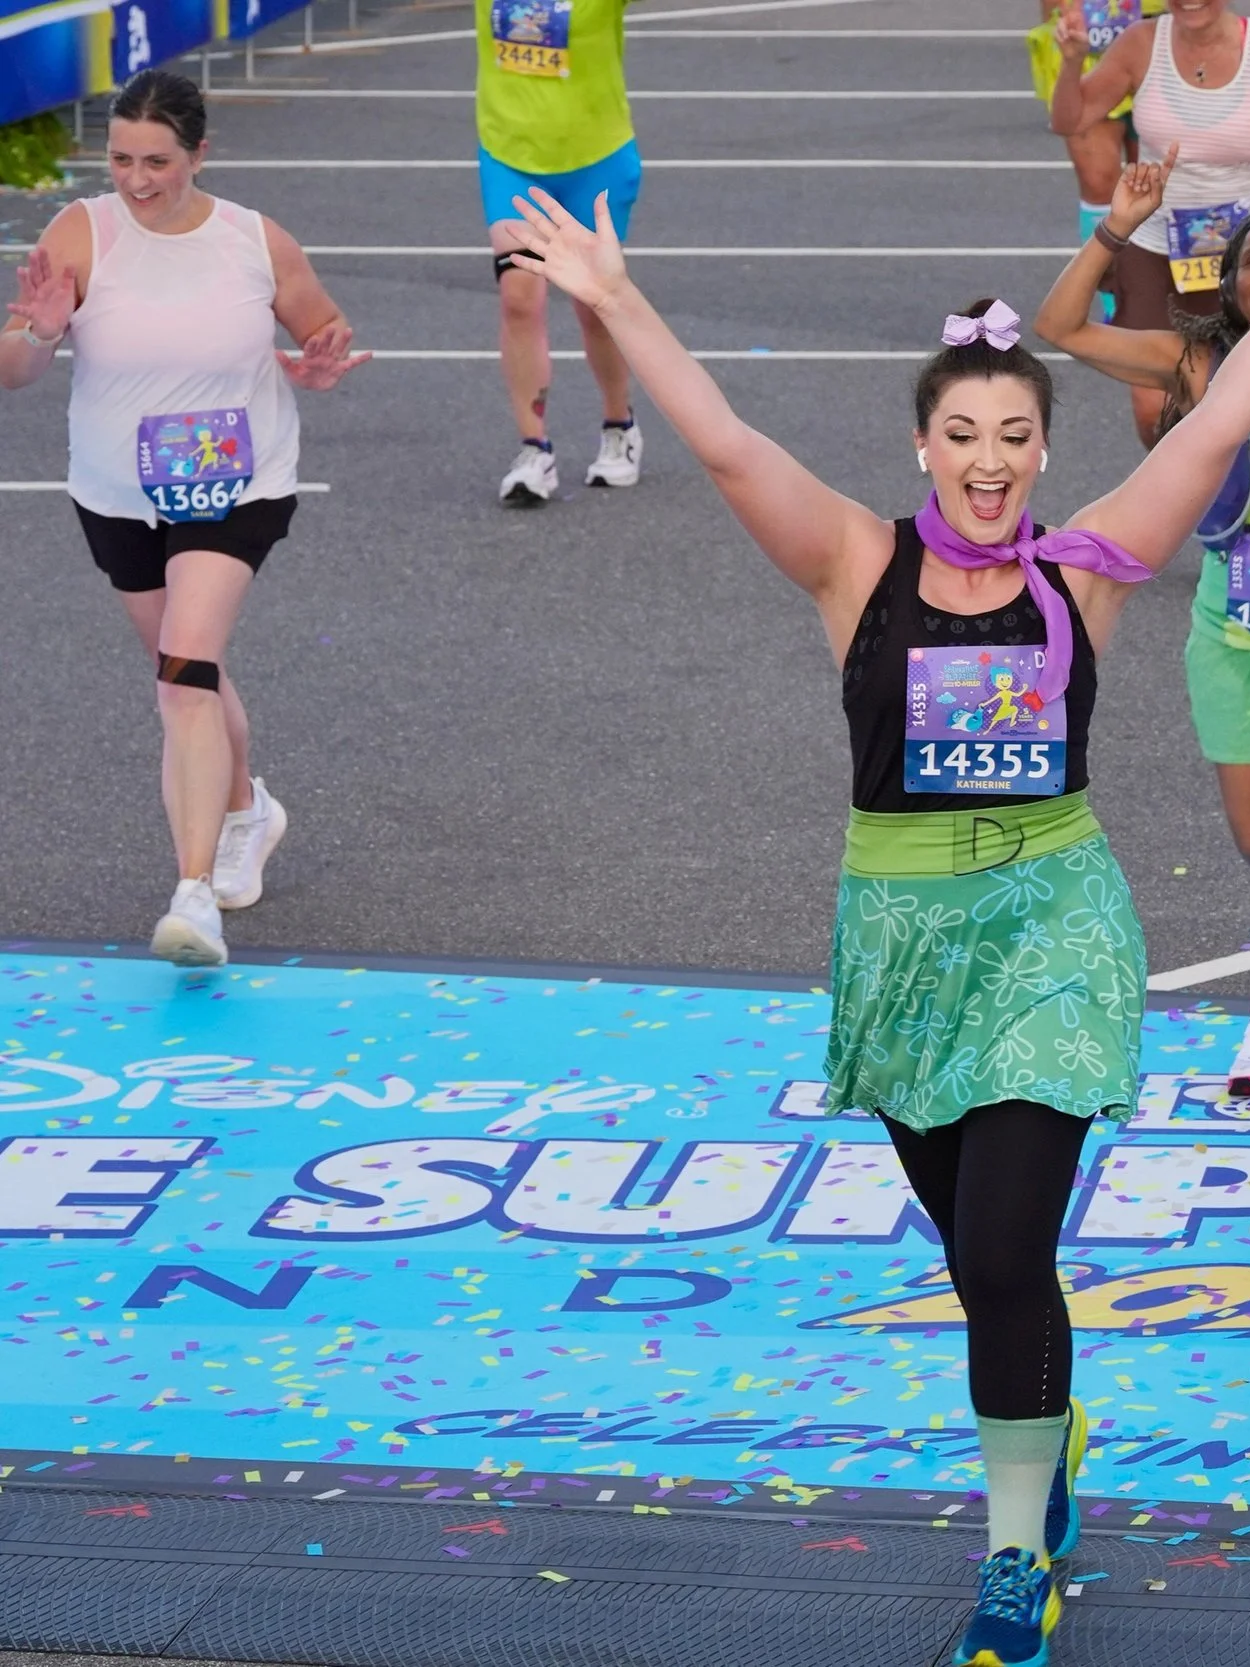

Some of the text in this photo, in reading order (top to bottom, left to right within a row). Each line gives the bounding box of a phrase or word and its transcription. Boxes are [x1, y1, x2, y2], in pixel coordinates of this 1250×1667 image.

[497, 43, 562, 67] 24414
[226, 412, 238, 426] D
[140, 441, 153, 476] 13664
[152, 479, 245, 511] 13664
[1232, 555, 1243, 589] 13535
[1034, 651, 1046, 668] D
[912, 683, 927, 727] 14355
[919, 743, 1050, 778] 14355
[956, 780, 1011, 790] KATHERINE
